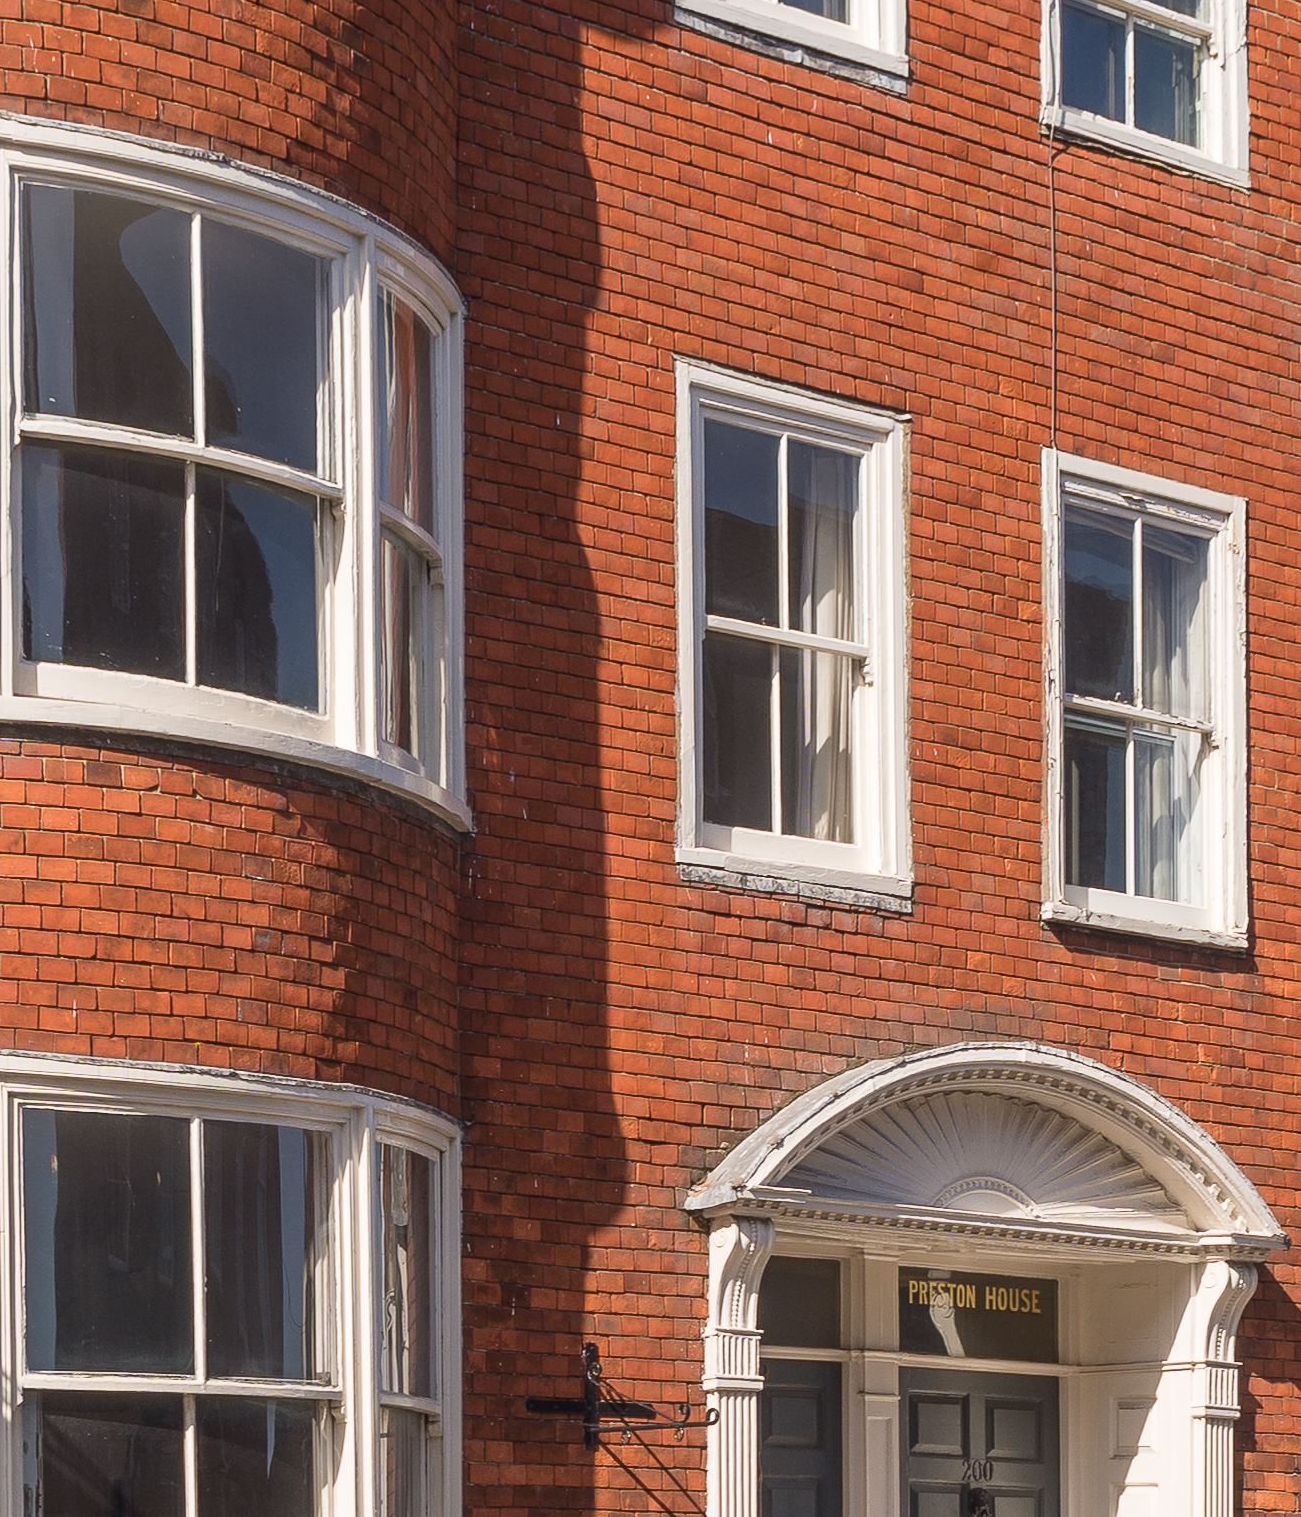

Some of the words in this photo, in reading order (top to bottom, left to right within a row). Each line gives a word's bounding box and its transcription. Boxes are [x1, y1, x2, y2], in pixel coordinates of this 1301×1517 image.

[908, 1280, 976, 1309] PRESTON
[985, 1286, 1042, 1314] HOUSE
[961, 1458, 994, 1482] 200
